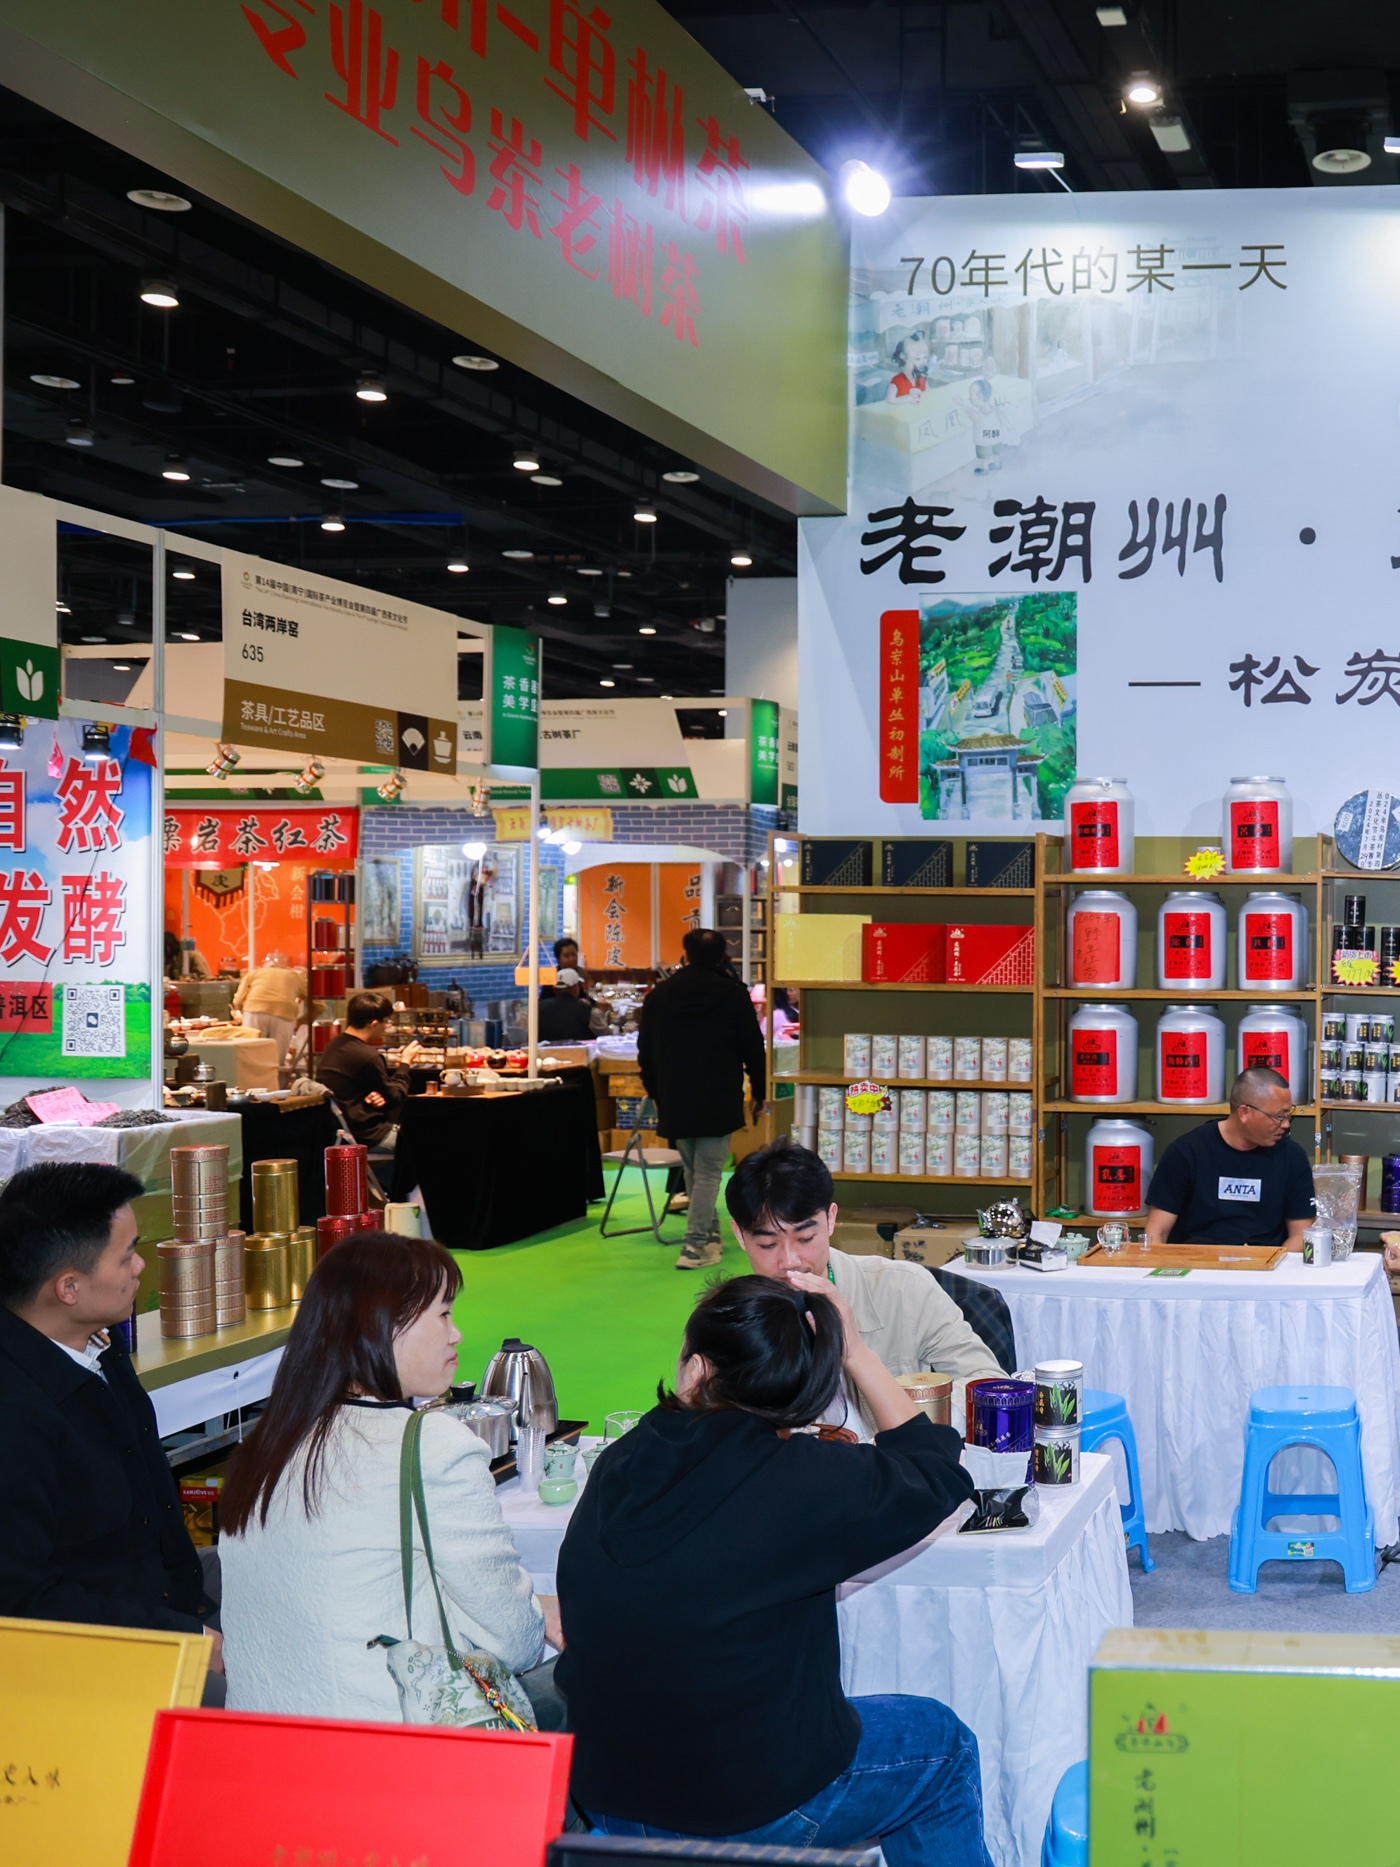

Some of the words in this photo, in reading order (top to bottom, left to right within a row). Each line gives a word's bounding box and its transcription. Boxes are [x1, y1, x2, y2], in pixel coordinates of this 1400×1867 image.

[900, 243, 1289, 298] 70年代的某一天
[242, 608, 299, 638] 台湾两岸窑
[242, 643, 264, 663] 635
[240, 700, 326, 732] 茶具/工艺品区
[1223, 1184, 1256, 1195] ANTA
